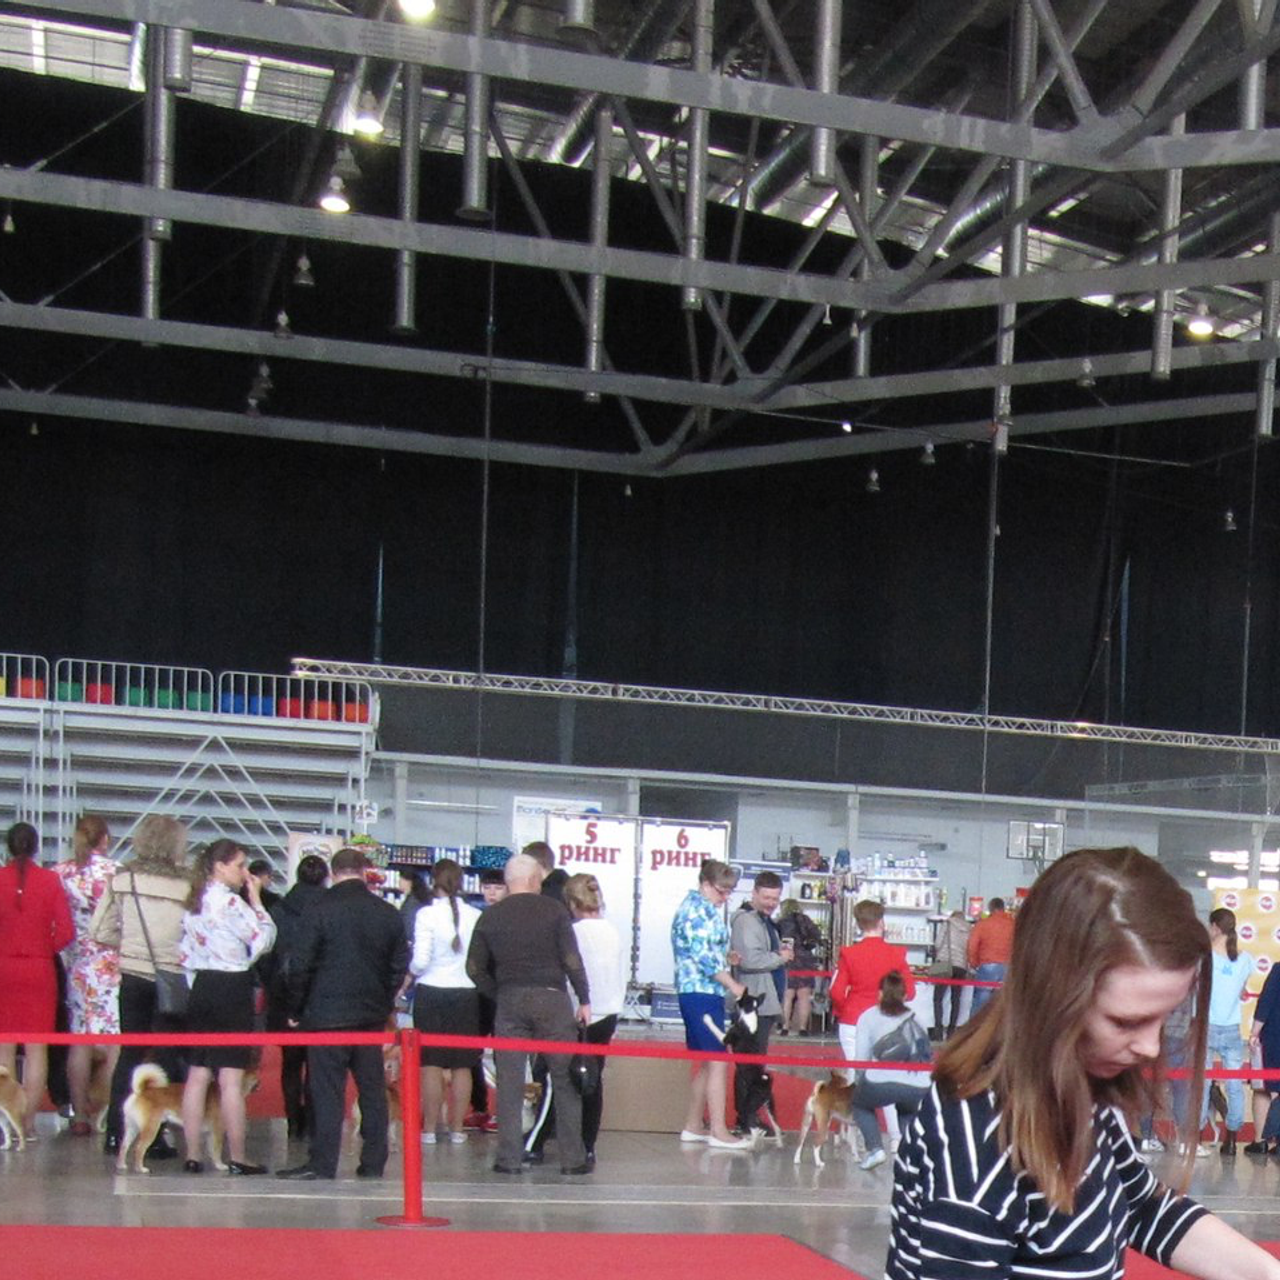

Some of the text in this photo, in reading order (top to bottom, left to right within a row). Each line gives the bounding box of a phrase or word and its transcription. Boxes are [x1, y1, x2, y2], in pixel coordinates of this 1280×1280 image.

[584, 822, 598, 844] 5
[676, 828, 689, 849] 6
[559, 844, 621, 866] ринг
